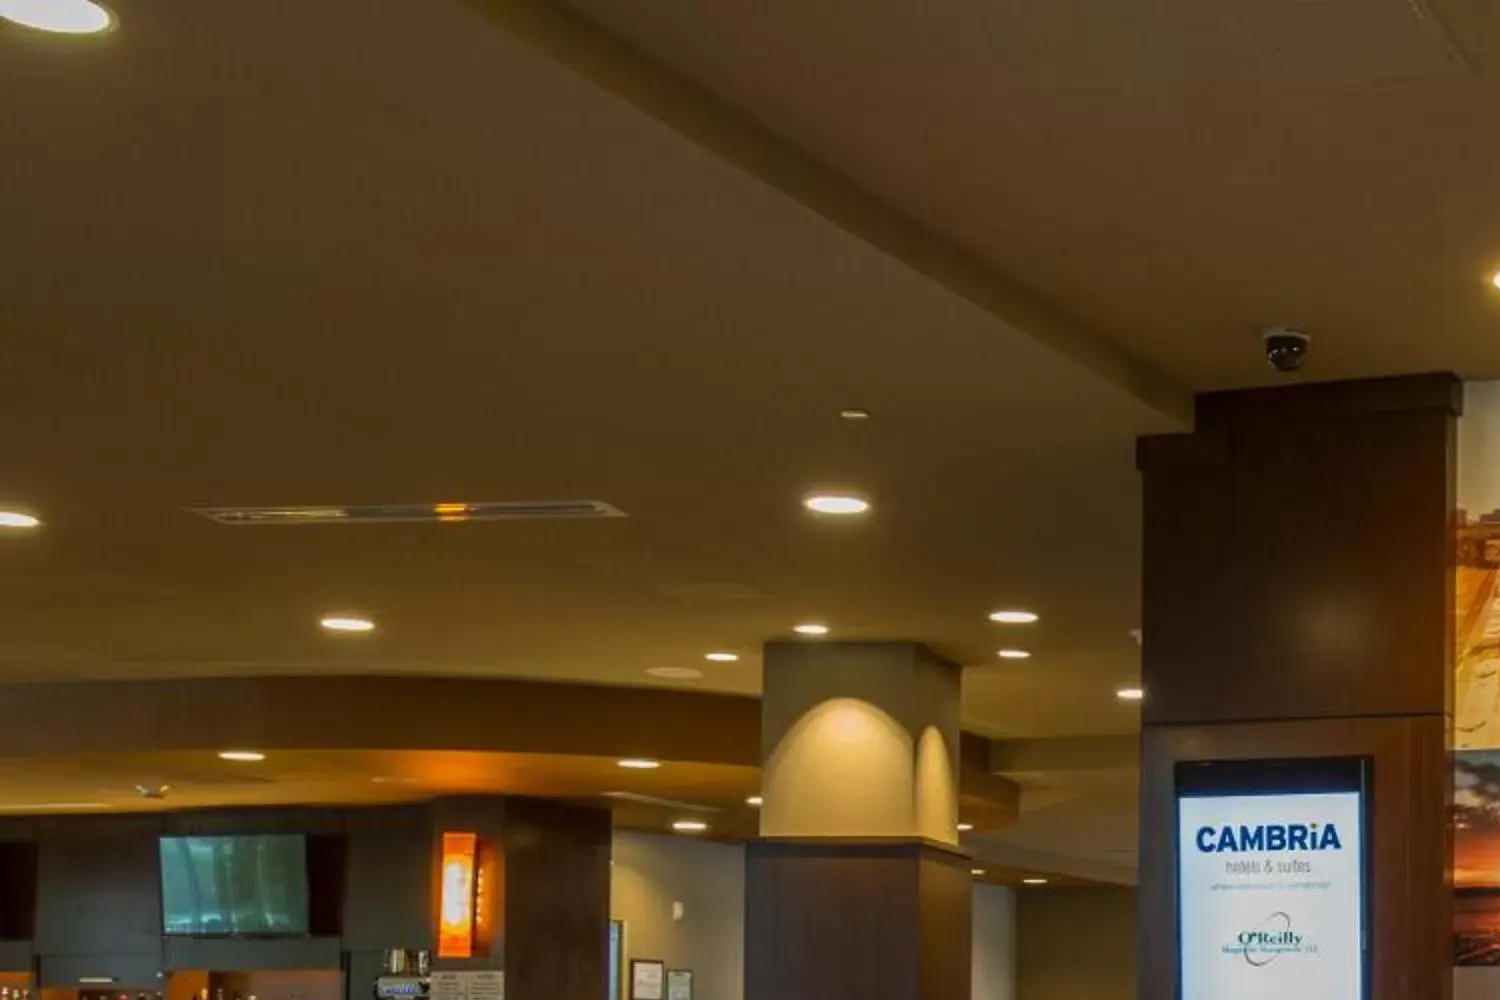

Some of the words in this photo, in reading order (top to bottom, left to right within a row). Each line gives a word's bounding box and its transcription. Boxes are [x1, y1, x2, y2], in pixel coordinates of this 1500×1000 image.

[1226, 859, 1261, 873] hotels
[1264, 859, 1273, 873] &
[1276, 858, 1312, 873] suites
